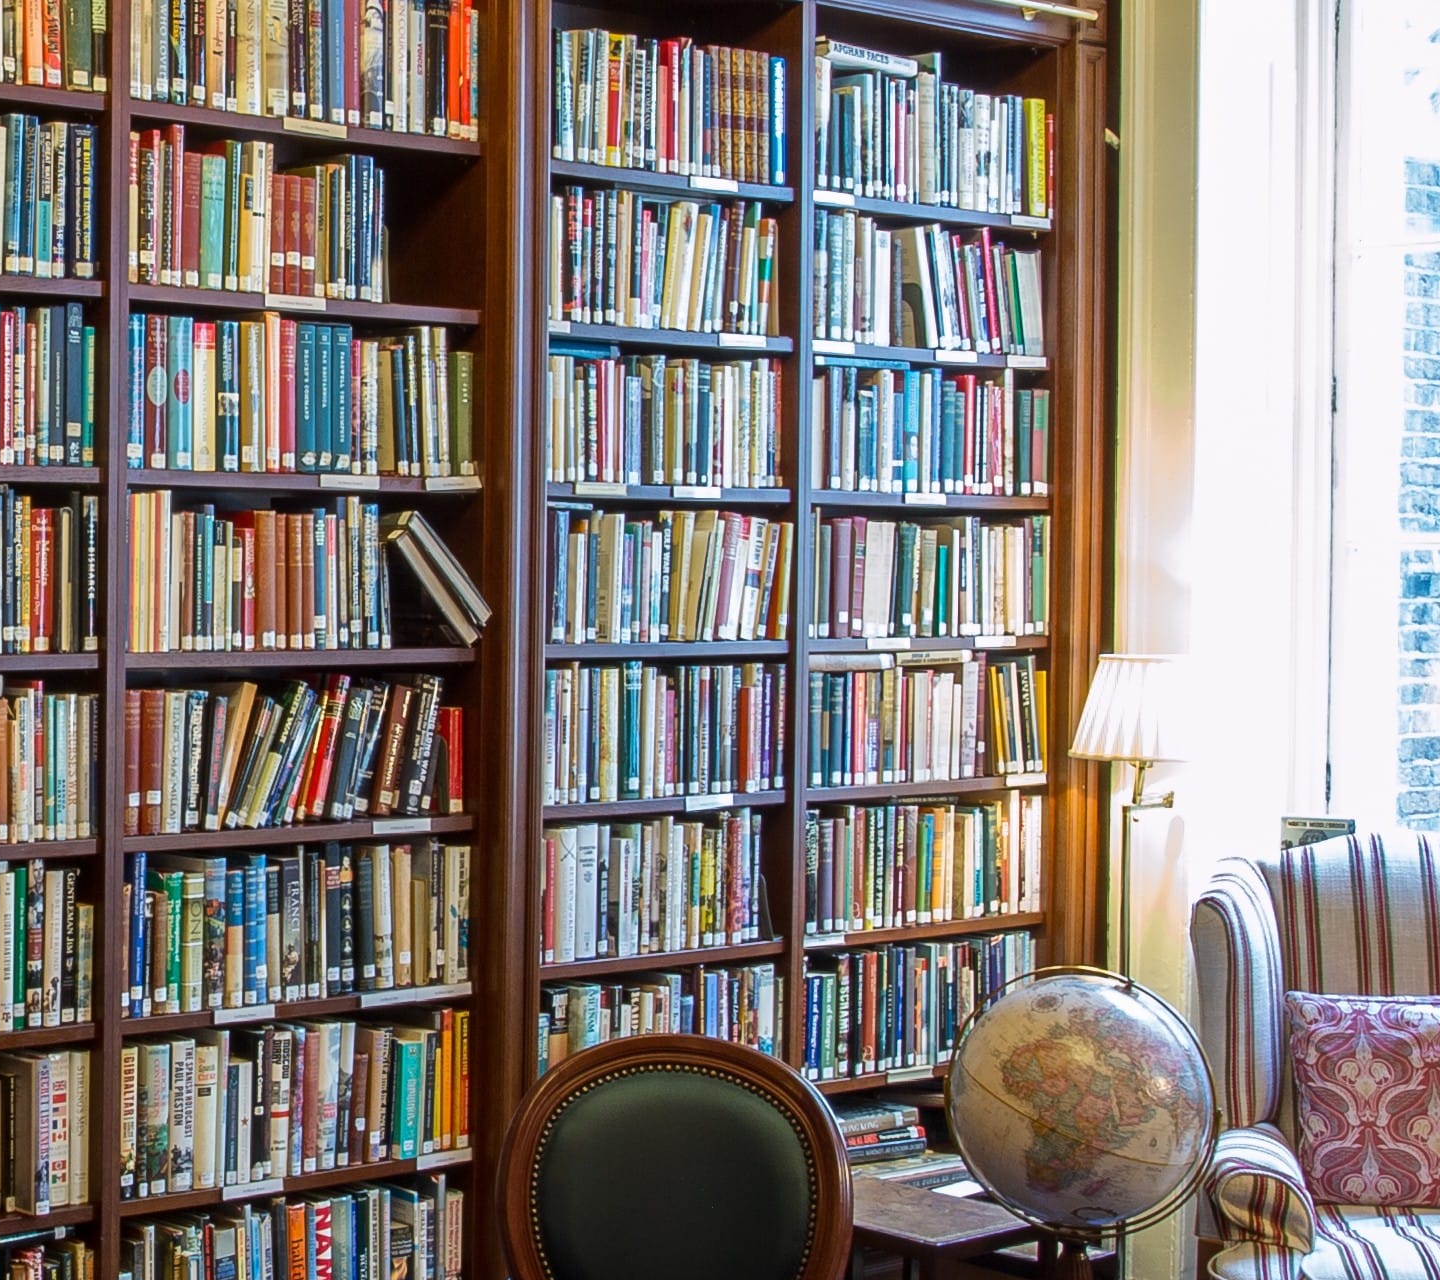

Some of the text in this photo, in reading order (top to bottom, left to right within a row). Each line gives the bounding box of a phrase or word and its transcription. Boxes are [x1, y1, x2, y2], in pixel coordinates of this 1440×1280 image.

[833, 44, 889, 64] AFGHAN FACES
[124, 1056, 135, 1118] GIBRALTAR
[174, 1061, 185, 1125] PAUL PRESTON
